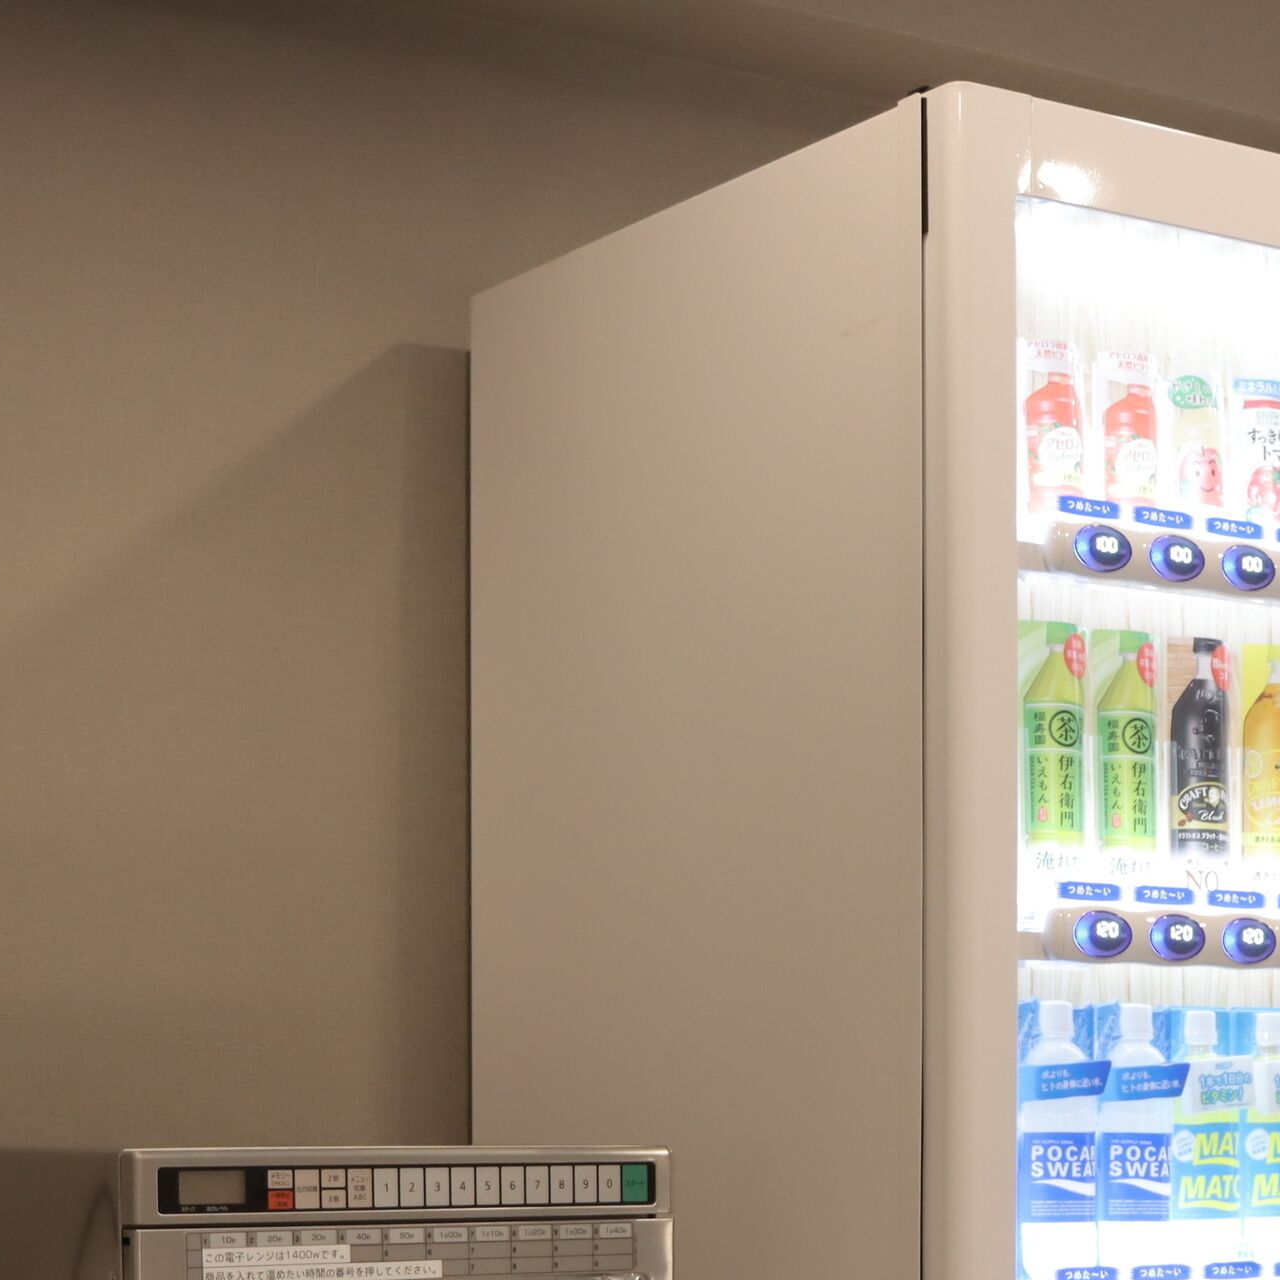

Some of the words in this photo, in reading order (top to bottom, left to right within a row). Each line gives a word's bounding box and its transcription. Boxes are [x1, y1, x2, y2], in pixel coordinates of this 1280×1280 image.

[1067, 499, 1111, 514] つめた〜い
[1141, 510, 1184, 525] つめた〜い
[1213, 520, 1255, 535] つめた〜い
[1056, 714, 1074, 741] 茶
[1130, 722, 1146, 749] 茶
[1037, 756, 1050, 804] いえもん
[1058, 754, 1075, 828] 伊右衛門
[1111, 763, 1122, 811] いえもん
[1131, 761, 1148, 834] 伊右衛門
[1178, 788, 1209, 811] CRAFT
[1067, 884, 1112, 897] つめた〜い
[1142, 888, 1186, 901] つめた〜い
[1215, 892, 1257, 905] つめた〜い
[1097, 921, 1119, 938] 120
[1171, 925, 1193, 941] 120
[1243, 928, 1264, 944] 120
[1041, 1069, 1071, 1080] 水よりも、
[1122, 1071, 1151, 1082] 水よりも、
[1199, 1072, 1252, 1088] 1本で1日分の
[1200, 1087, 1242, 1104] ビタミン!
[384, 1183, 389, 1193] 1
[409, 1183, 415, 1193] 2
[435, 1182, 441, 1192] 3
[459, 1182, 466, 1191] 4
[485, 1181, 491, 1191] 5
[509, 1181, 516, 1191] 6
[535, 1180, 541, 1190] 7
[559, 1180, 565, 1190] 8
[583, 1179, 589, 1189] 9
[606, 1179, 613, 1189] 0
[205, 1250, 346, 1264] この電子レンジは1400wです。
[1064, 1269, 1109, 1280] つめた〜い
[1139, 1266, 1183, 1279] つめた〜い
[1211, 1265, 1252, 1276] つめた〜い
